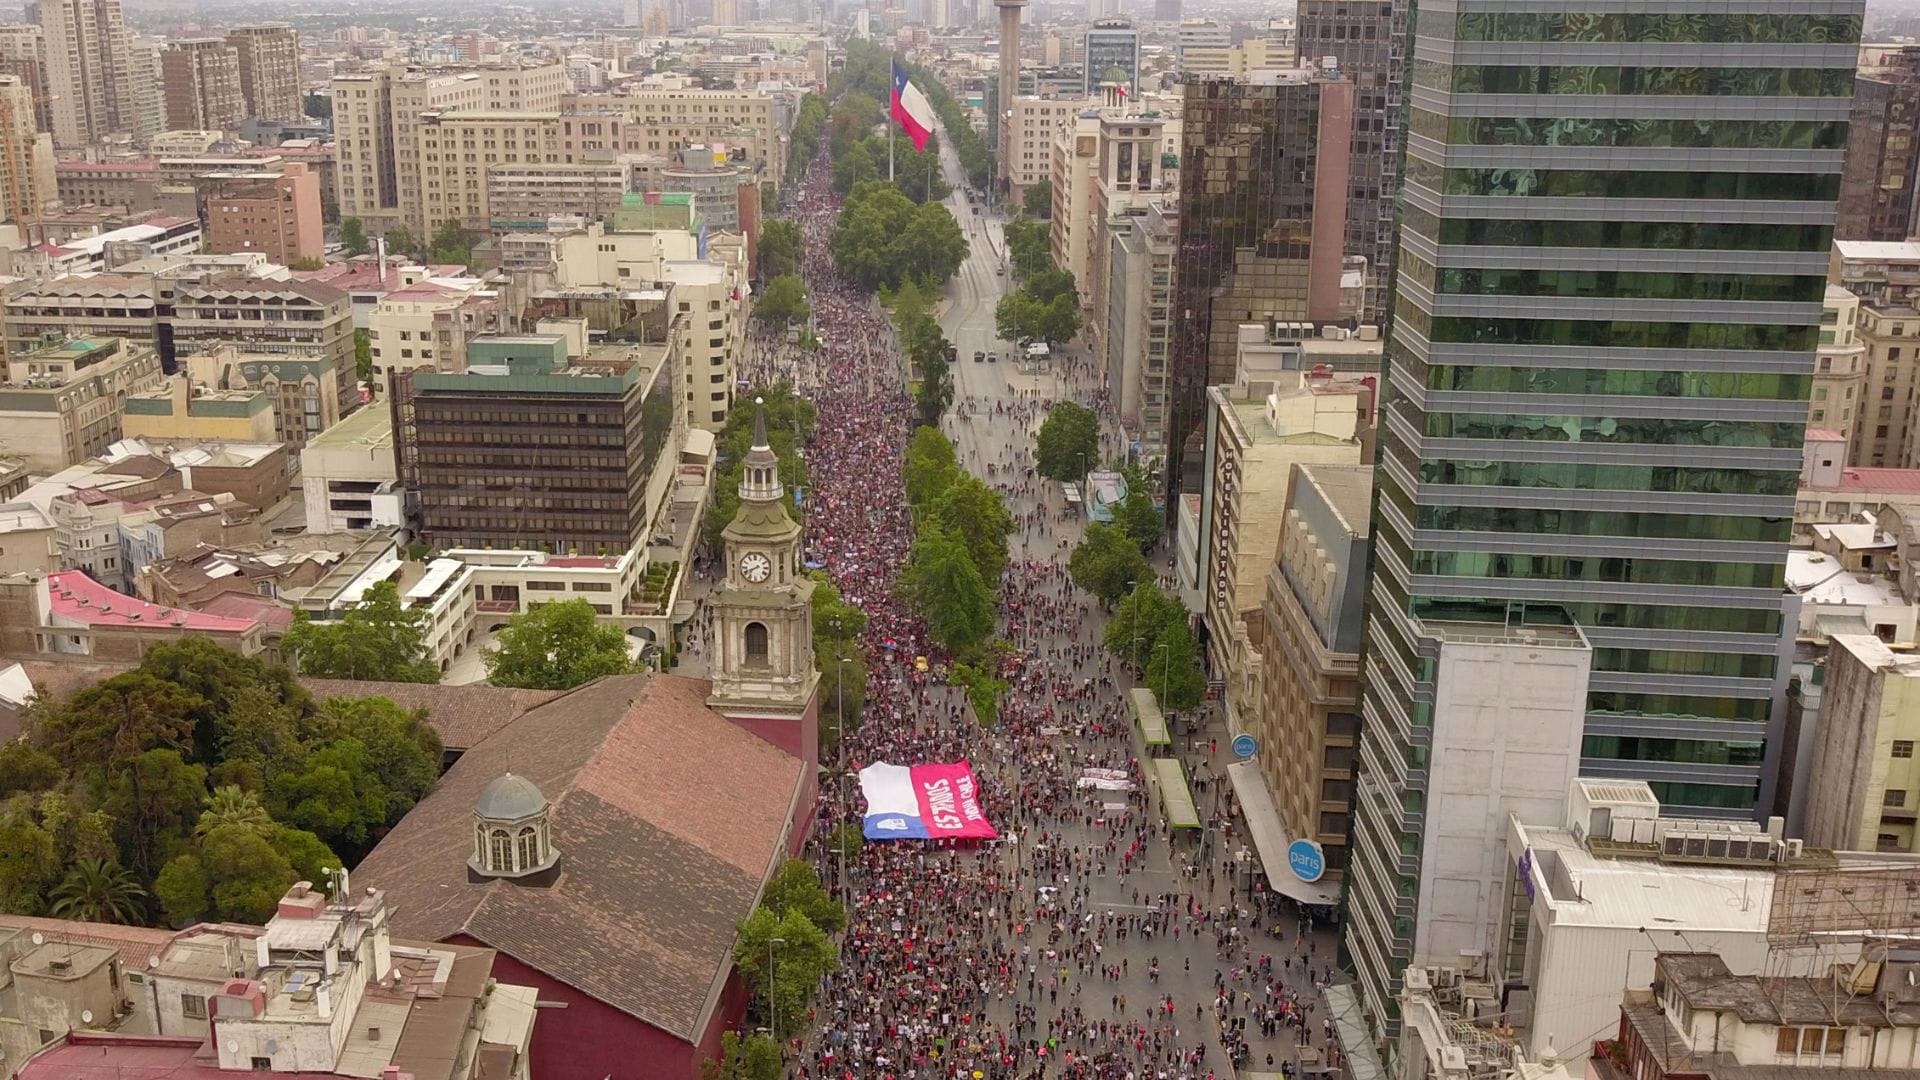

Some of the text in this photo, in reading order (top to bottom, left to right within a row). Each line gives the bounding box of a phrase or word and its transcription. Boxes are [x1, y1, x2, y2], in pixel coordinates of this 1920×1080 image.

[1218, 452, 1233, 608] HOTEL LIBERTADOR
[1290, 851, 1320, 870] paris
